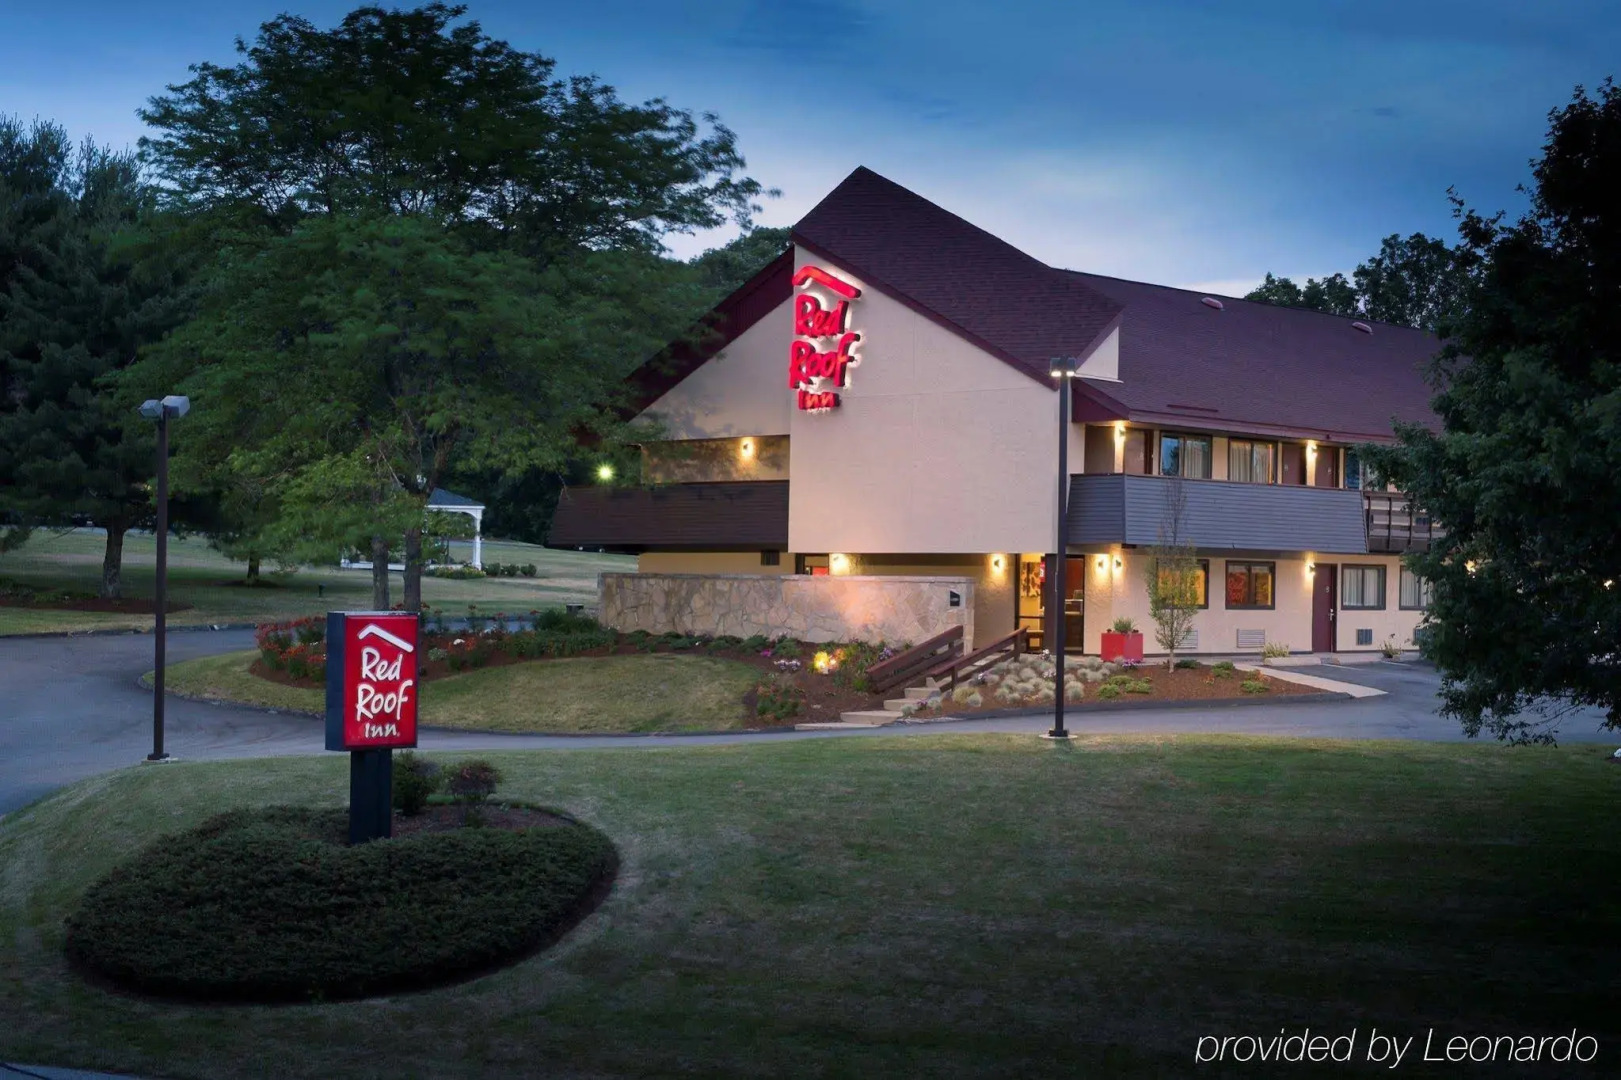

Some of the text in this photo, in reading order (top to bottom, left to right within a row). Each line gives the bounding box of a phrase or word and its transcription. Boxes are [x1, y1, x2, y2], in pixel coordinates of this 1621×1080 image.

[795, 294, 849, 338] Red
[789, 332, 860, 389] Roof
[798, 390, 841, 410] Inn
[361, 646, 403, 682] Red
[356, 680, 413, 722] Roof
[365, 723, 398, 738] Inn
